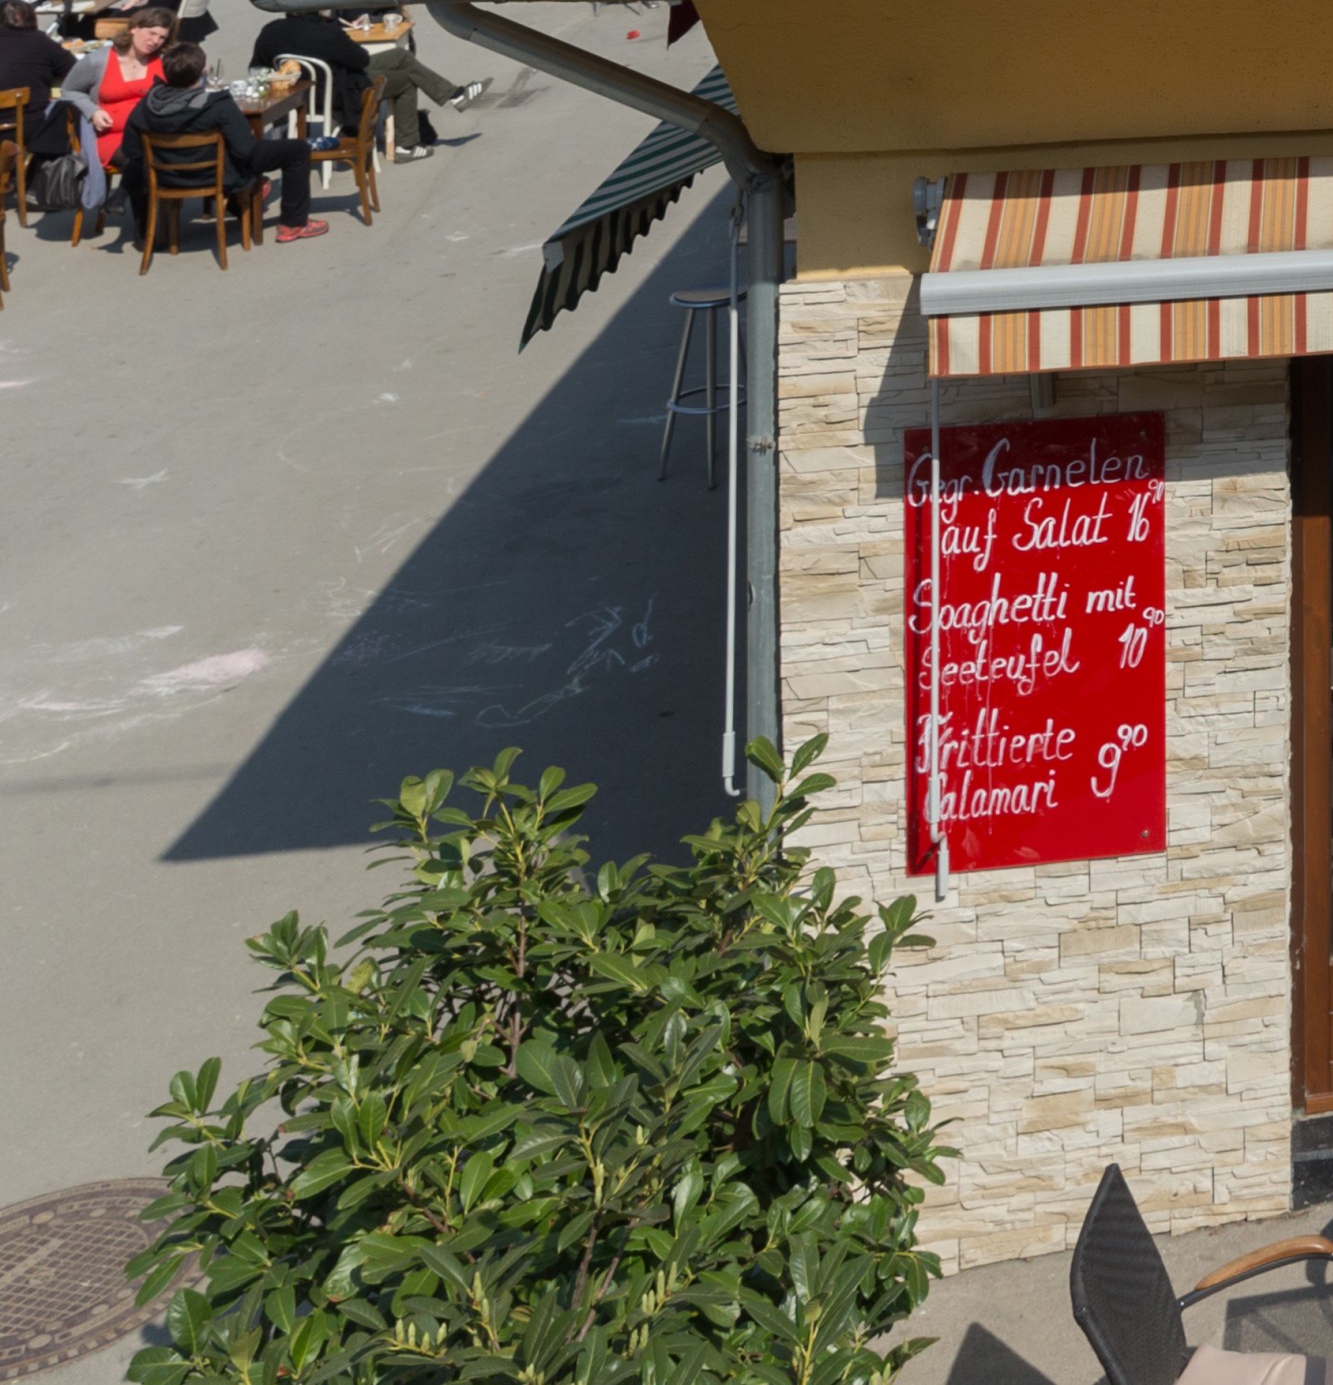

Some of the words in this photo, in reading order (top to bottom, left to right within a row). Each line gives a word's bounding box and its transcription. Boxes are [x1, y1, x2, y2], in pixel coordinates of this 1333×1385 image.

[940, 507, 998, 572] auf
[1012, 492, 1113, 552] Salat
[908, 571, 1071, 645] Spaghetti
[1085, 575, 1137, 614] mit
[917, 627, 1080, 697] Seeteufel
[915, 707, 1076, 774] Frittierte
